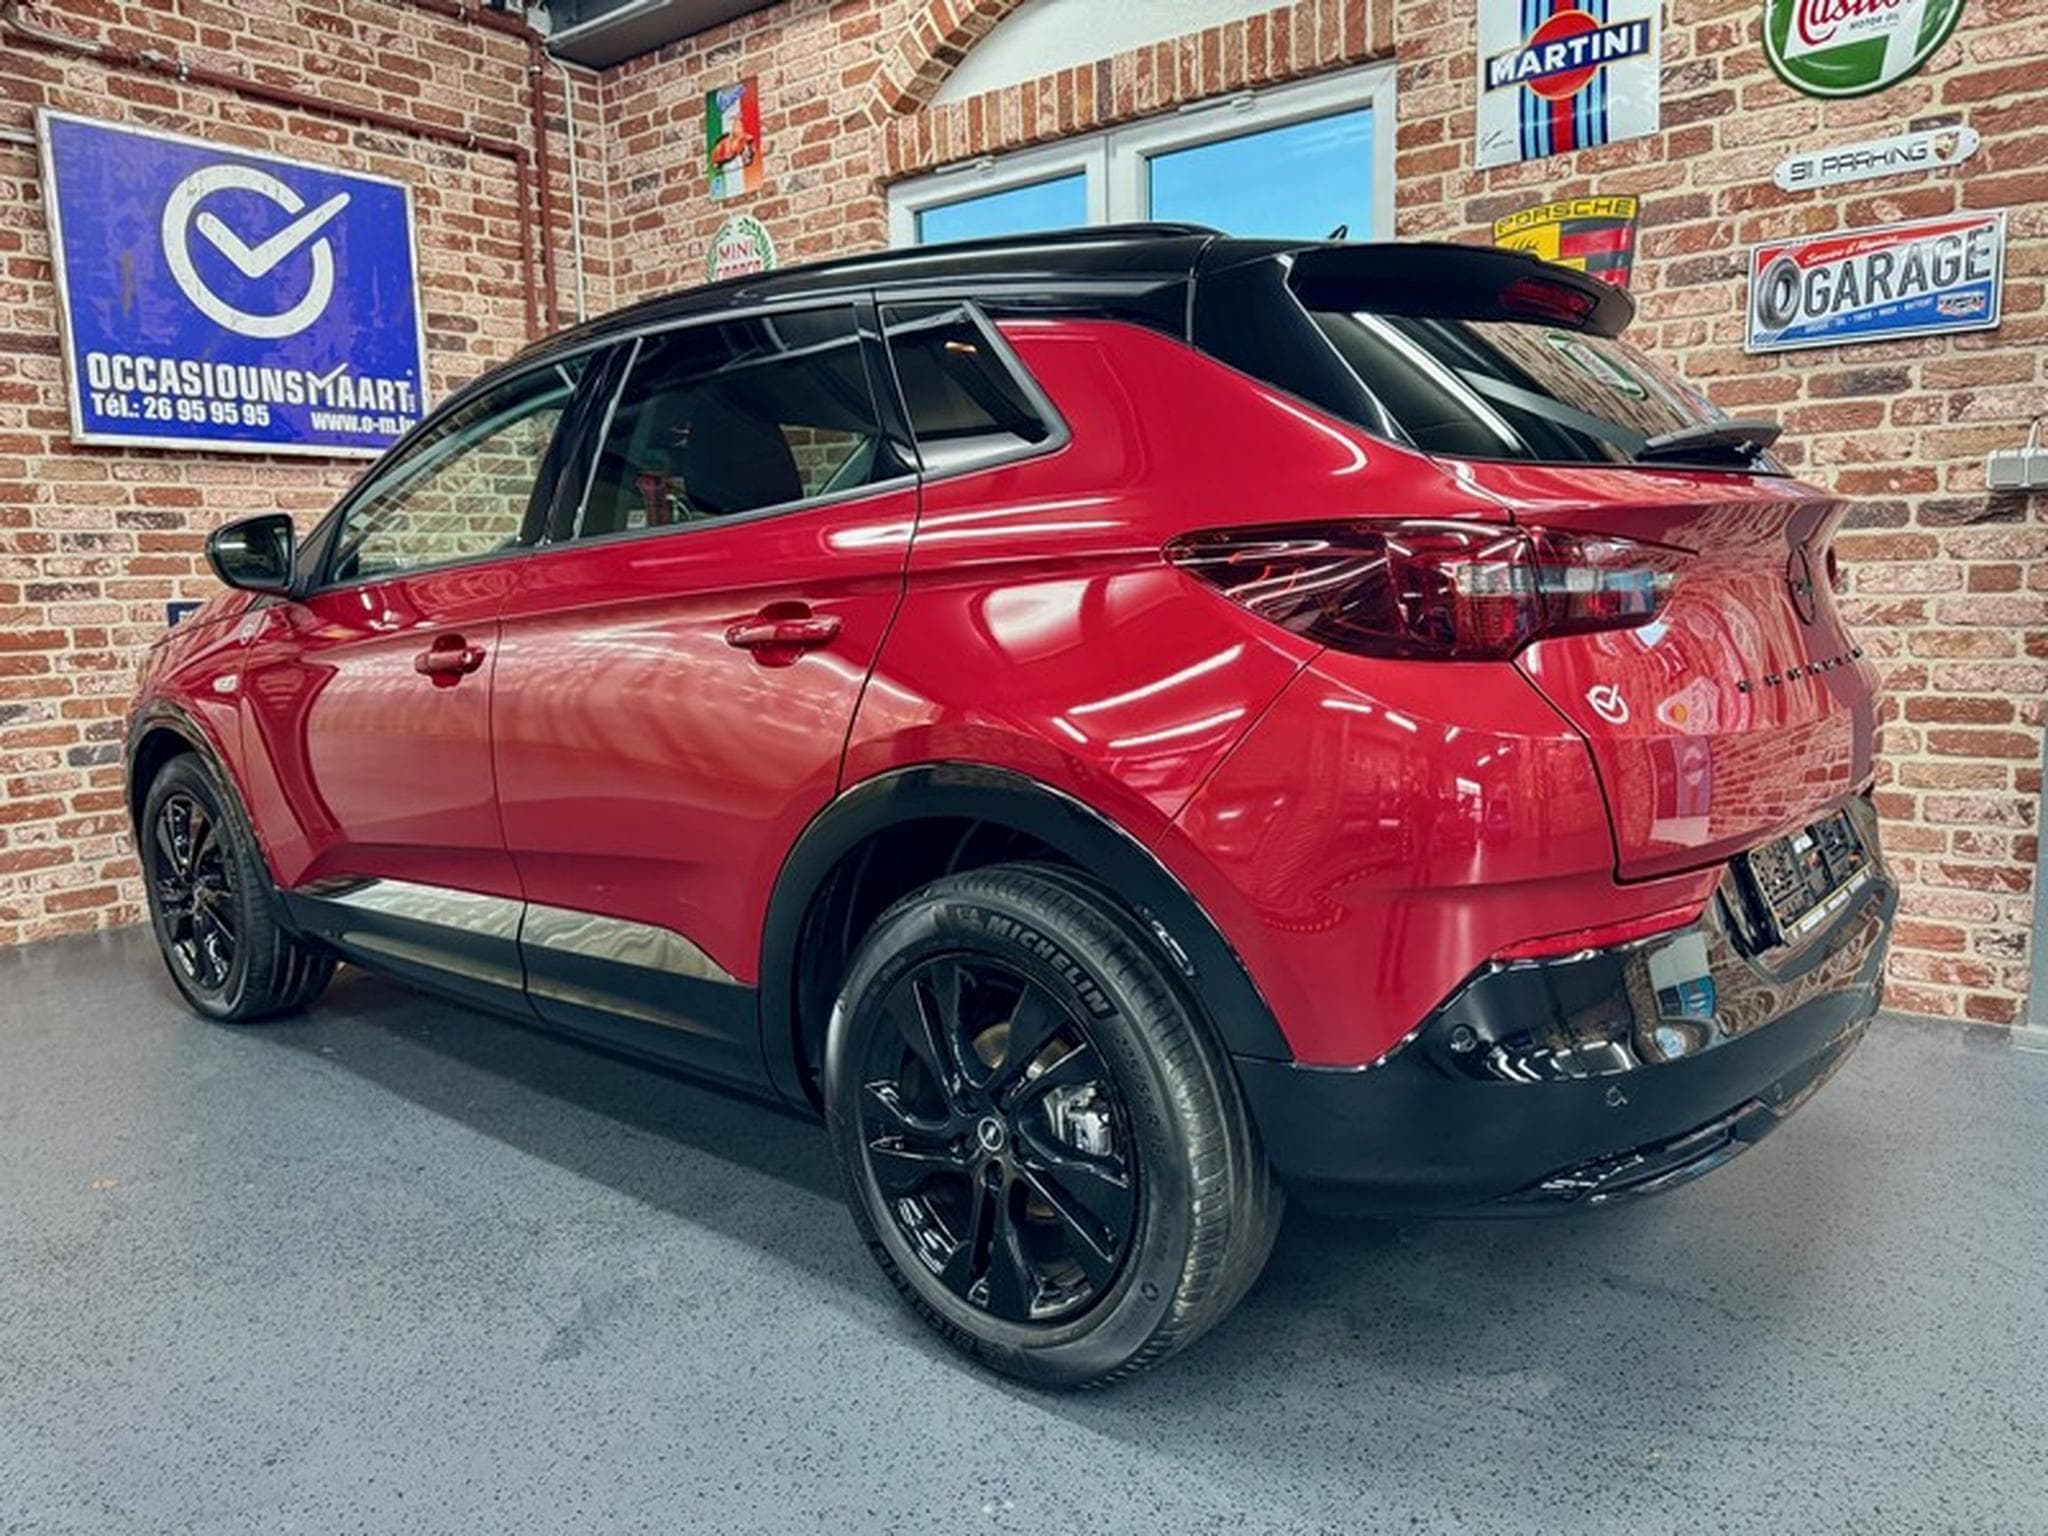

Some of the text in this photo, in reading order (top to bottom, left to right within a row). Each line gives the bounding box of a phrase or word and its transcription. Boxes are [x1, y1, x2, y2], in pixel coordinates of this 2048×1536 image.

[1490, 24, 1643, 86] MARTINI
[1821, 140, 1928, 177] PARKING
[1497, 199, 1632, 234] PORSCHE
[1804, 225, 1994, 318] GARAGE
[86, 352, 412, 414] OCCASIOUNSMAART
[143, 396, 174, 421] 26
[177, 398, 207, 423] 95
[210, 400, 240, 426] 95
[242, 403, 271, 427] 95
[986, 915, 1110, 1014] MICHELIN
